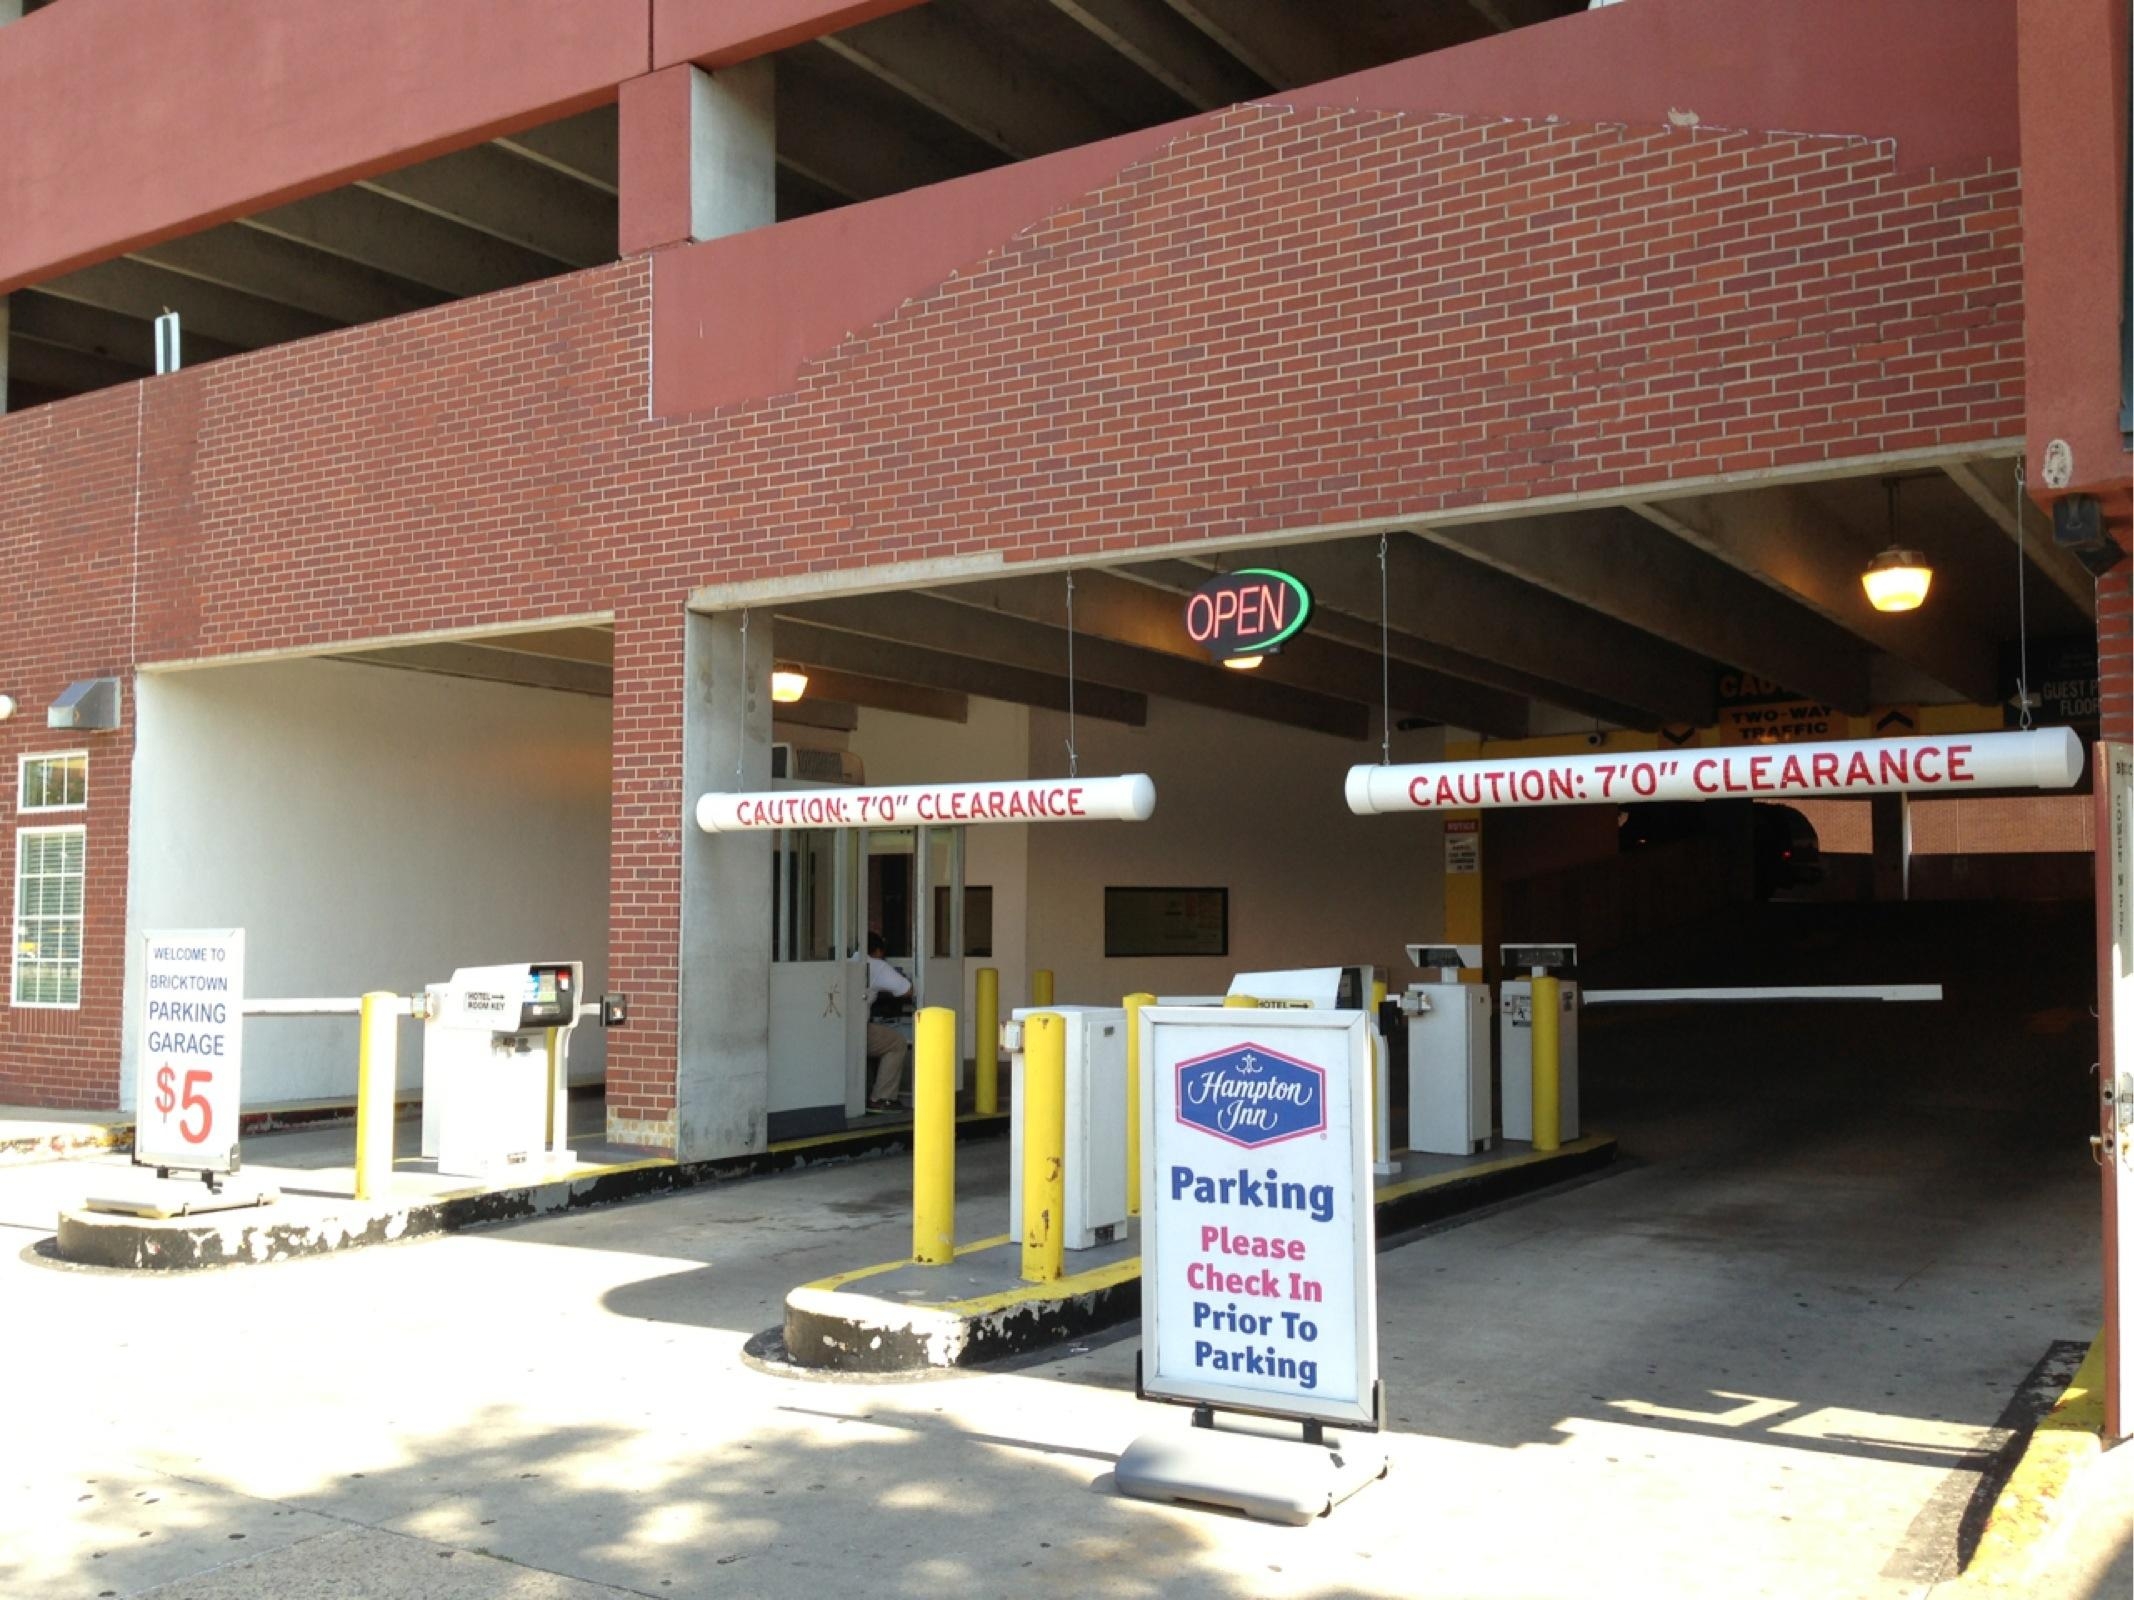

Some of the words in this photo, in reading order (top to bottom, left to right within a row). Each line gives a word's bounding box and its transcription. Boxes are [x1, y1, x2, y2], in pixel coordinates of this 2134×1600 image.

[1187, 582, 1286, 641] OPEN
[2043, 680, 2085, 699] GUEST
[1731, 704, 1832, 723] TWO-WAY
[1739, 722, 1829, 739] TRAFFIC
[1408, 768, 1587, 806] CAUTION:
[1692, 745, 1974, 793] CLEARANCE
[737, 797, 850, 826] CAUTION:
[917, 788, 1086, 820] CLEARANCE
[154, 947, 207, 961] WELCOME
[211, 948, 225, 962] TO
[150, 974, 228, 992] BRICKTOWN
[149, 1001, 226, 1024] PARKING
[148, 1031, 224, 1056] GARAGE
[155, 1062, 213, 1145] $5
[1188, 1070, 1313, 1106] Hampton
[1218, 1099, 1278, 1132] Inn
[1171, 1166, 1334, 1222] Parking
[1201, 1226, 1306, 1260] Please
[1187, 1262, 1281, 1298] Check
[1289, 1272, 1323, 1302] In
[1193, 1301, 1273, 1337] Prior
[1281, 1311, 1318, 1342] To
[1195, 1340, 1318, 1390] Parking
